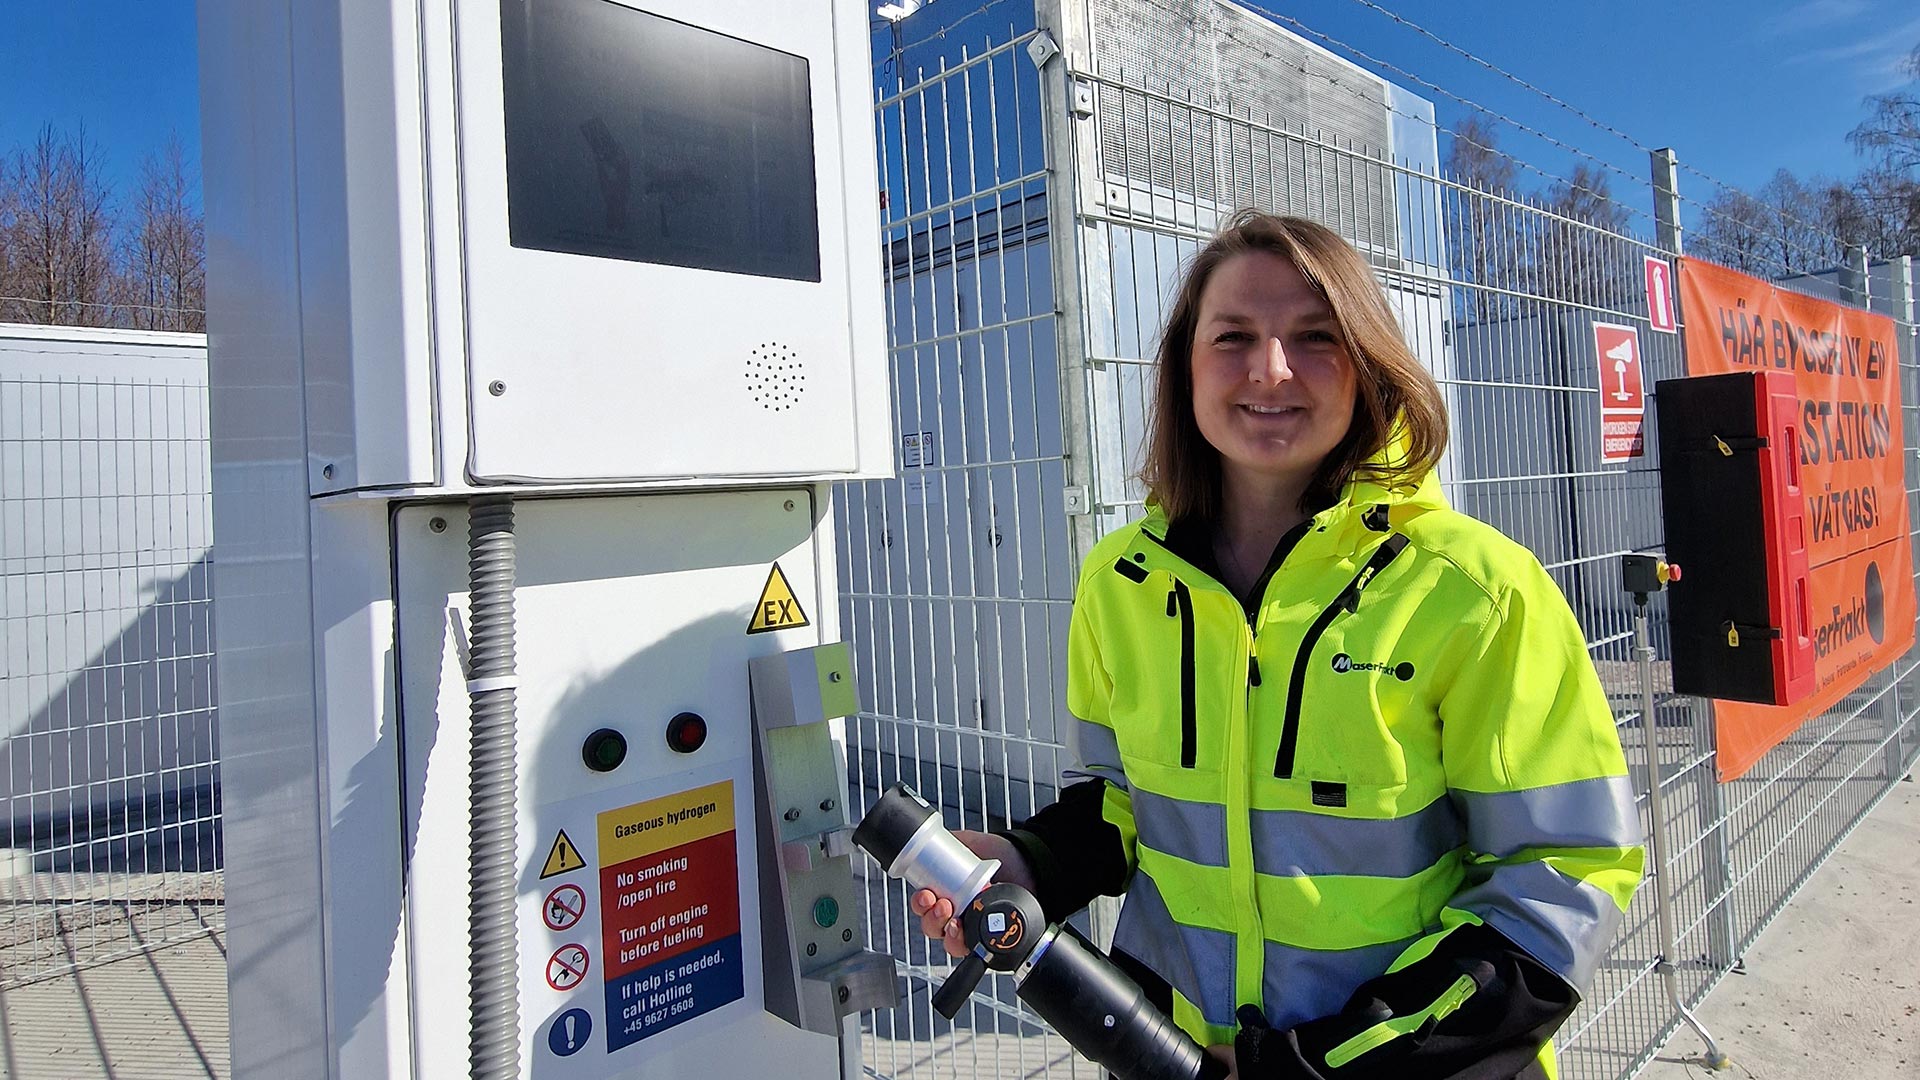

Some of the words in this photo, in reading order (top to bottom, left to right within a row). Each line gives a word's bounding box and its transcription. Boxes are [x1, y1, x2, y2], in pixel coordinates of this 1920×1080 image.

[1719, 298, 1767, 366] HÄR
[1808, 482, 1879, 543] VÄTGAS!
[763, 598, 794, 626] EX
[614, 816, 664, 838] Gaseous
[666, 802, 716, 825] hydrogen
[616, 873, 634, 888] No
[637, 857, 688, 882] smoking
[617, 888, 652, 910] /open
[656, 880, 677, 896] fire
[619, 925, 647, 943] Turn
[650, 915, 666, 933] off
[669, 904, 709, 924] engine
[620, 940, 660, 964] before
[663, 924, 704, 948] fueling
[622, 983, 631, 1000] If
[634, 975, 661, 995] help
[664, 969, 676, 983] is
[679, 949, 725, 977] needed,
[622, 997, 646, 1020] call
[649, 983, 693, 1009] Hotline
[623, 1018, 643, 1036] +45
[644, 1007, 669, 1027] 9627
[671, 997, 695, 1016] 5608
